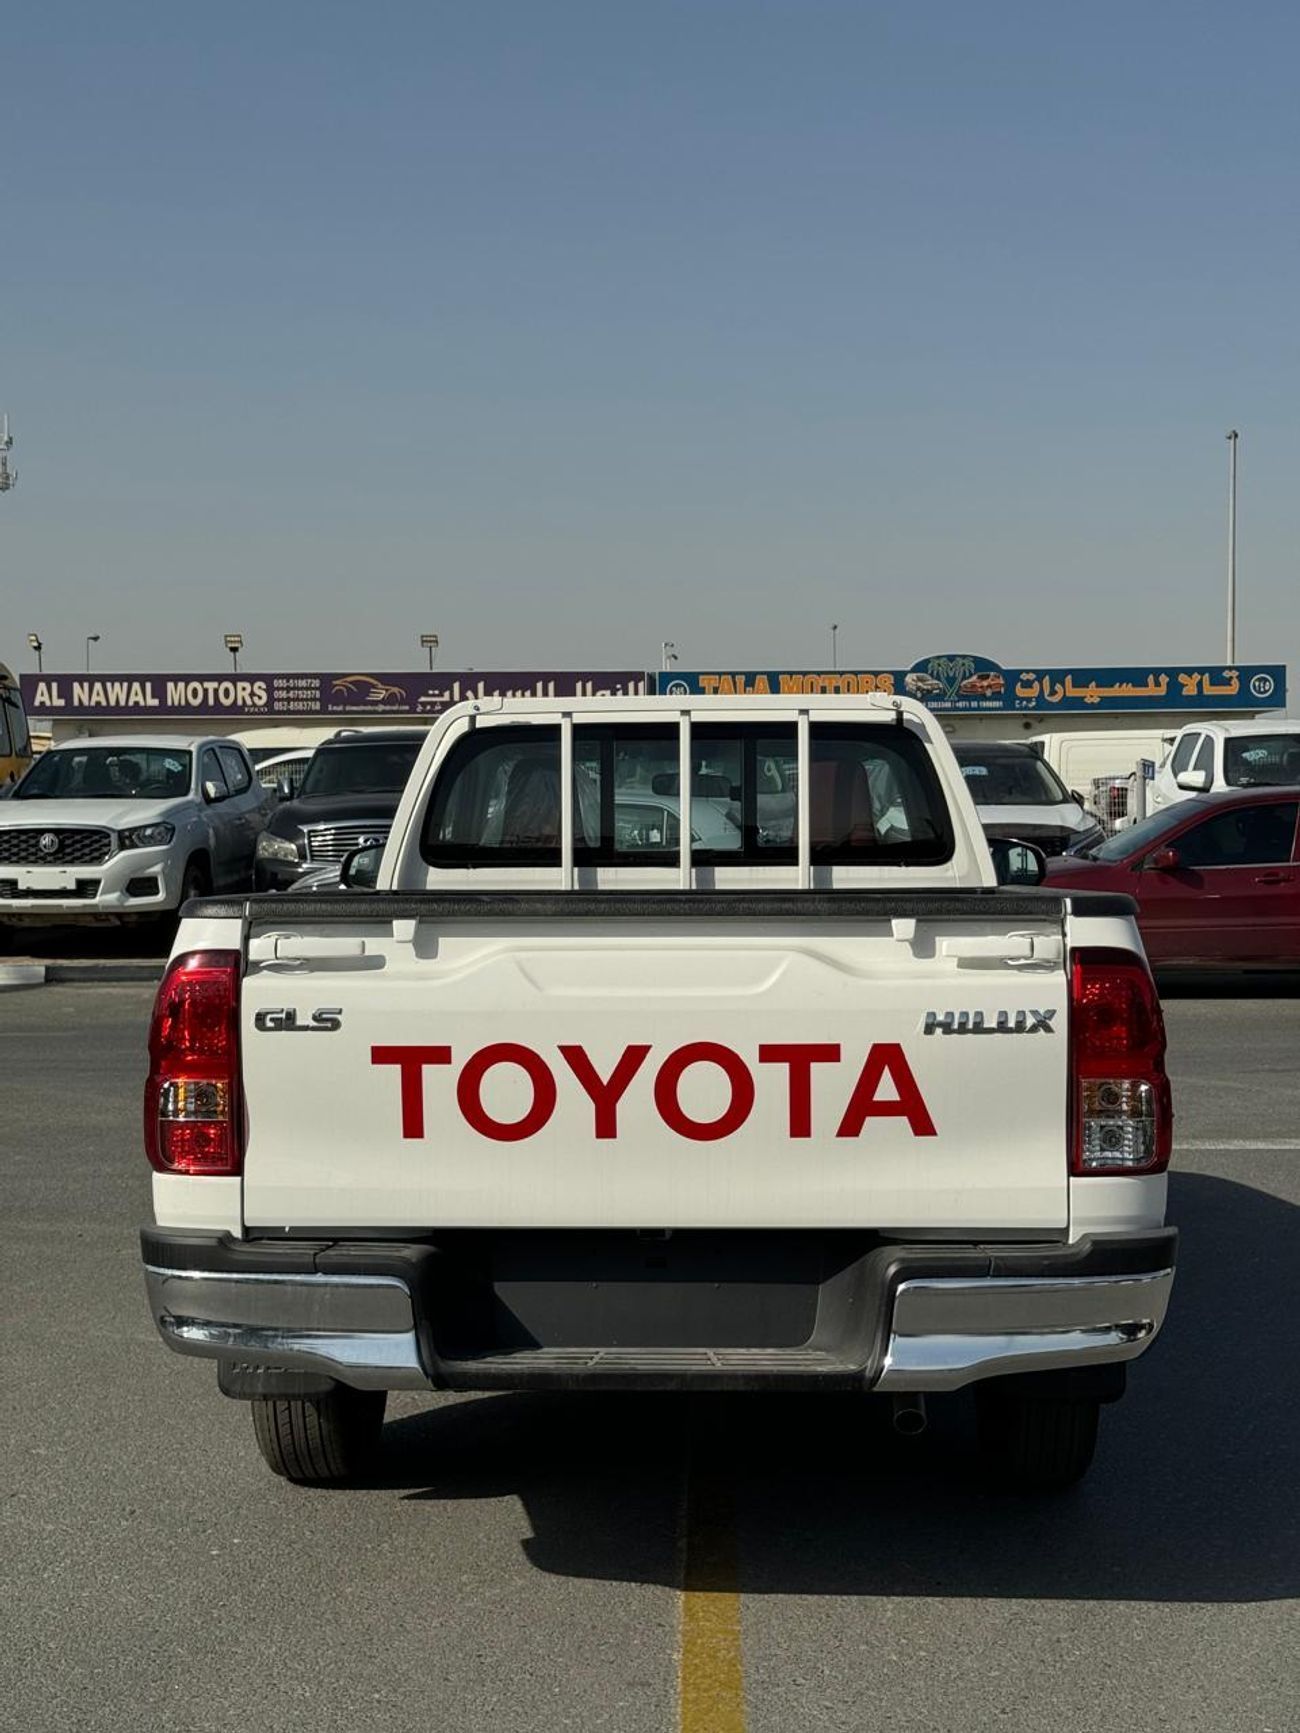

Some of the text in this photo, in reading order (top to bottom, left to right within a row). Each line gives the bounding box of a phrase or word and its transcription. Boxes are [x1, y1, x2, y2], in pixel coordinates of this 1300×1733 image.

[33, 681, 268, 706] AL NAWAL MOTORS
[699, 674, 894, 696] TALA MOTORS
[1015, 669, 1240, 703] تالا للسيارات
[254, 1007, 343, 1032] GLS
[923, 1009, 1057, 1035] HILUX
[371, 1041, 938, 1141] TOYOTA
